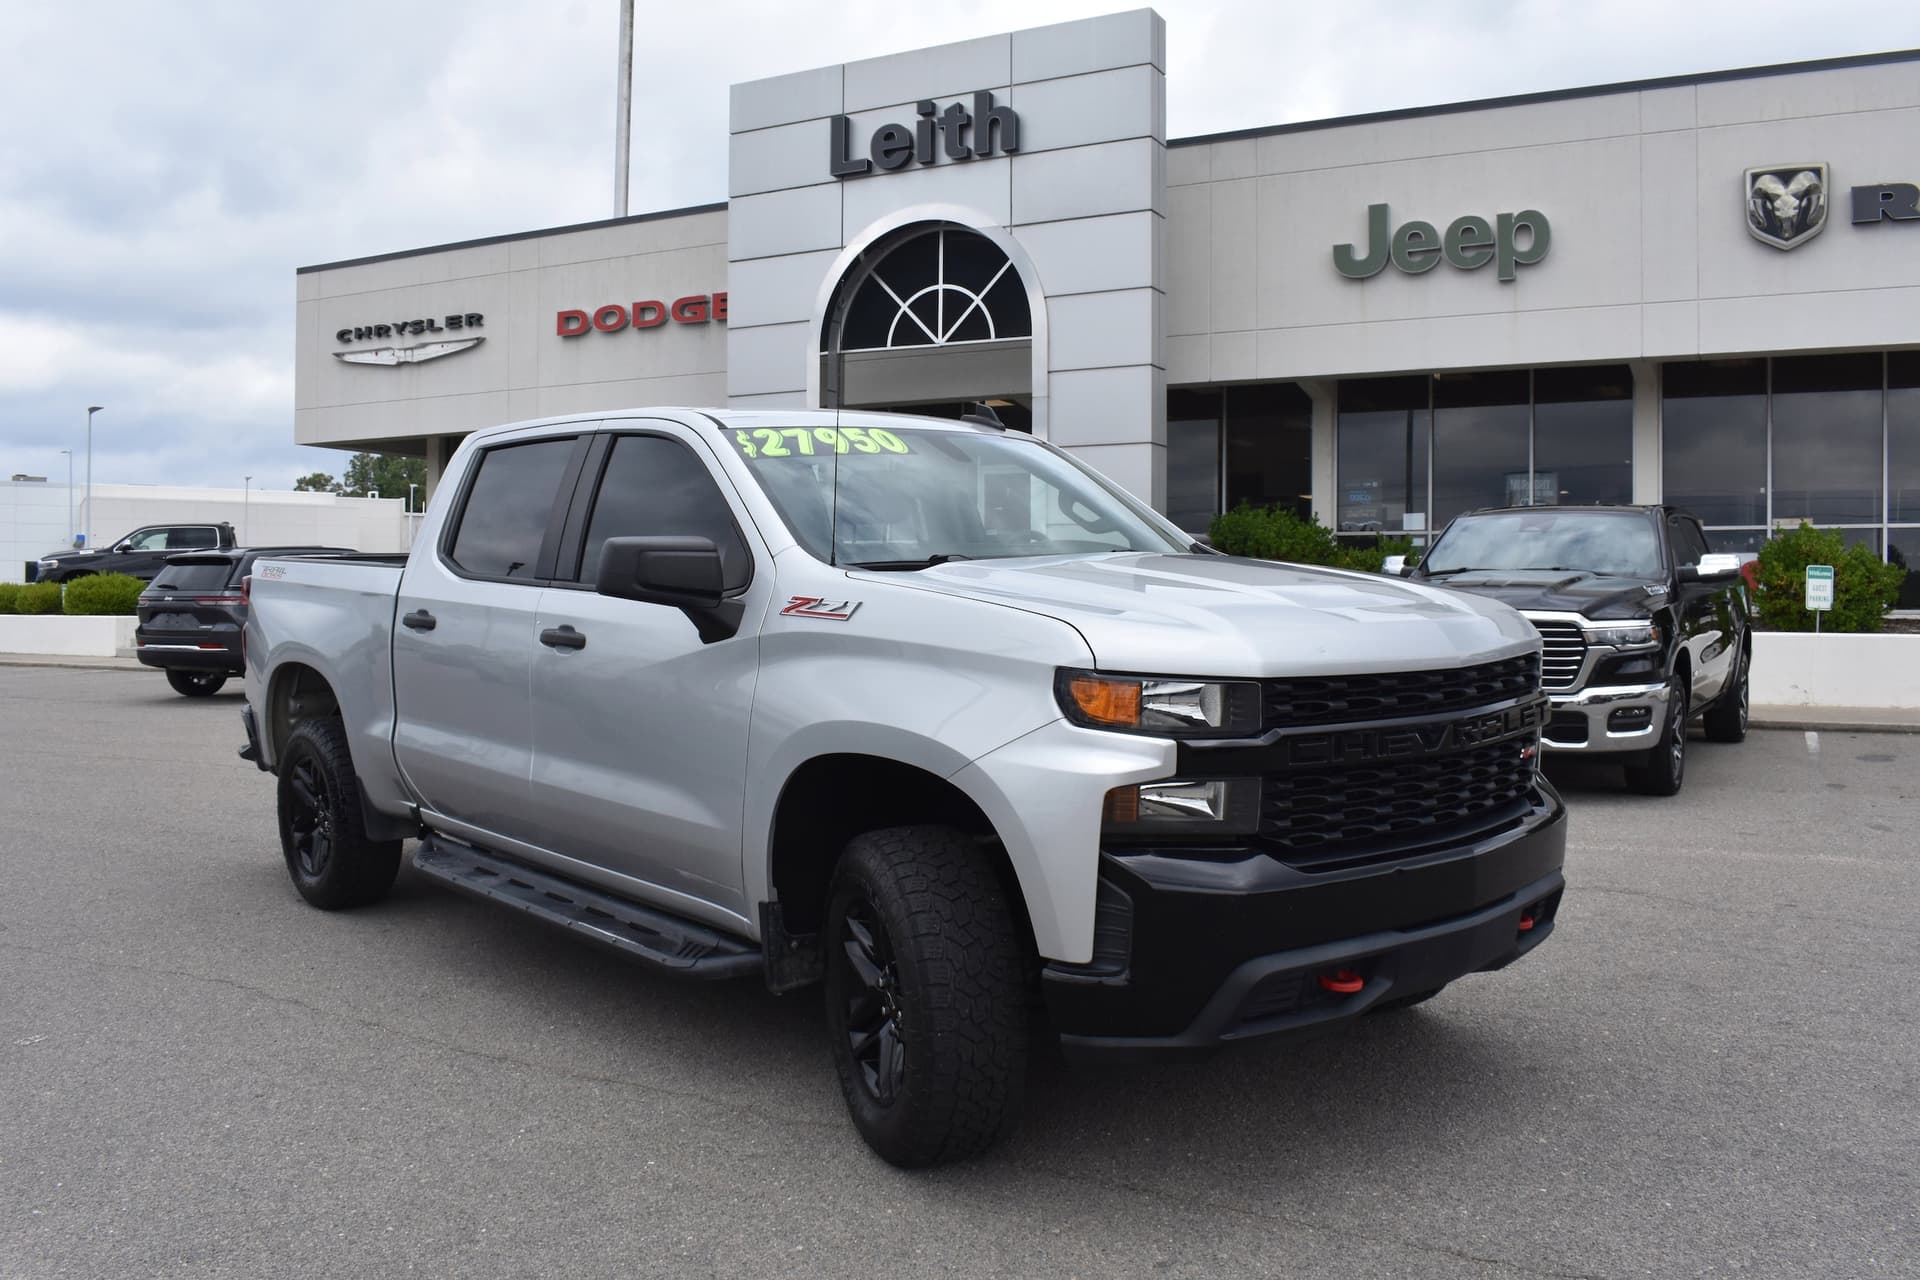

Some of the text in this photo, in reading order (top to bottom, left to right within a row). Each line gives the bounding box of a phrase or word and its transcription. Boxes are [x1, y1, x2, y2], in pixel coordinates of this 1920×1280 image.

[829, 90, 1020, 178] Leith
[1332, 203, 1551, 282] Jeep
[336, 312, 485, 344] CHRYSLER
[736, 427, 910, 458] $27950
[779, 596, 863, 621] Z71
[1288, 703, 1550, 766] CHEVROLET
